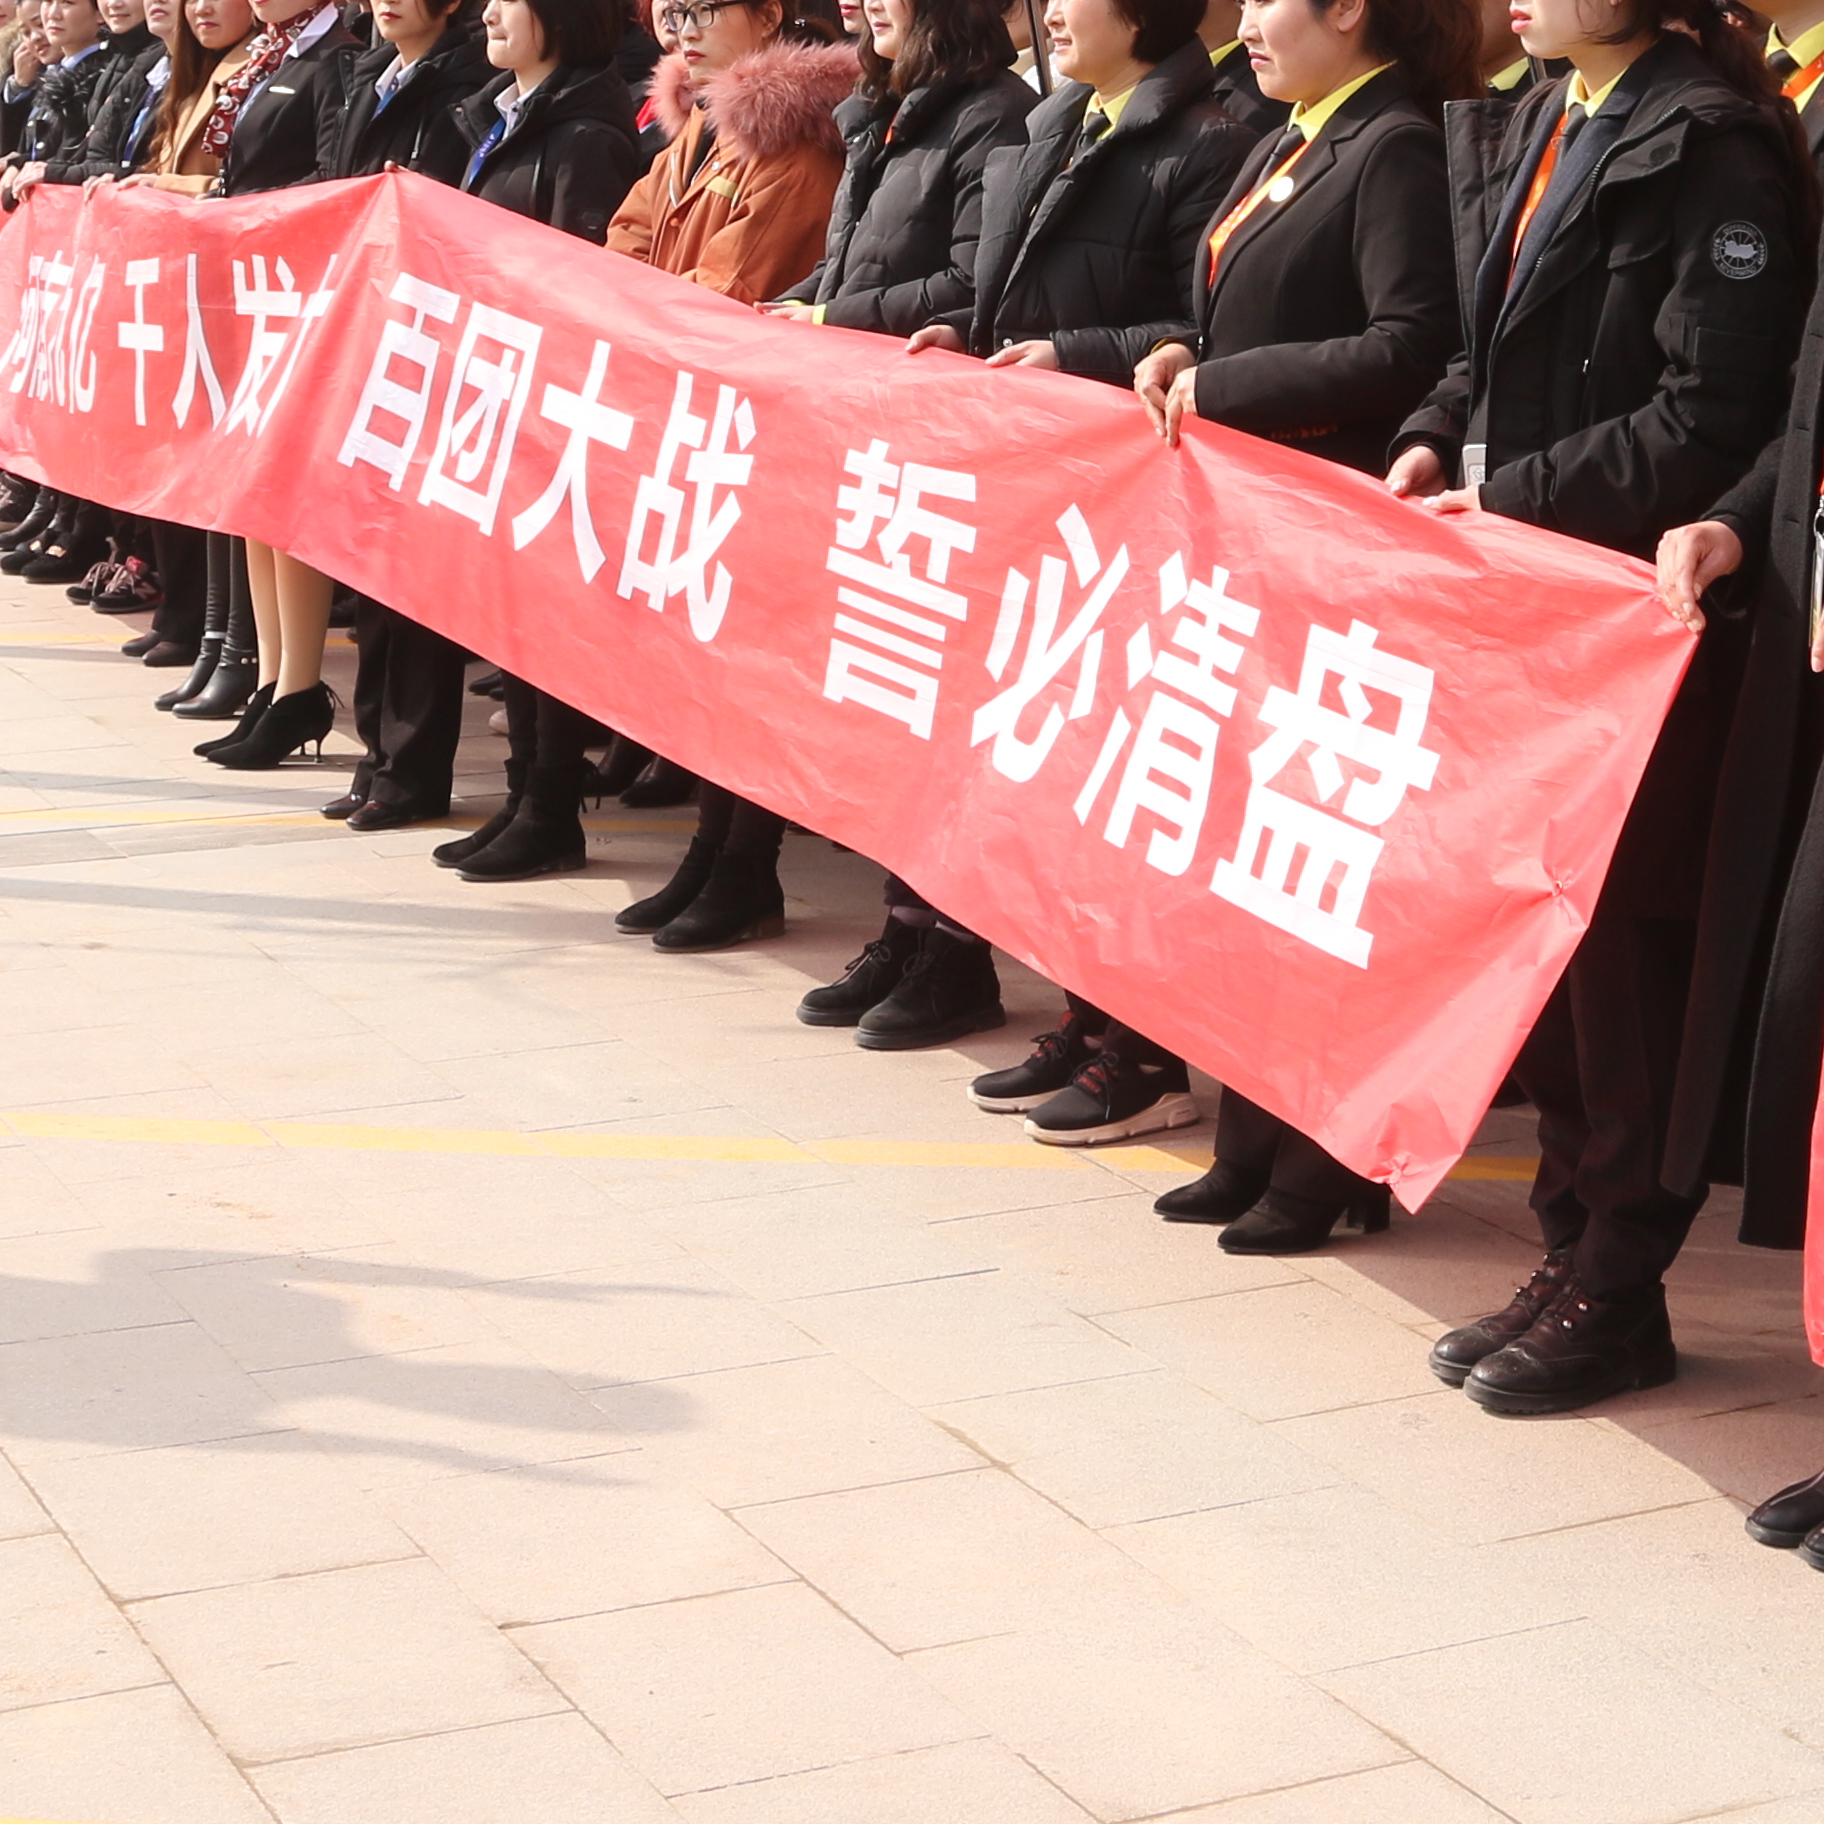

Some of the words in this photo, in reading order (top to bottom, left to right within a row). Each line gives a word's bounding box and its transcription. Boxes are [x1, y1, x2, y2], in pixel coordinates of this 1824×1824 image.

[337, 270, 756, 643] 百团大战
[824, 437, 1441, 970] 誓必清盘
